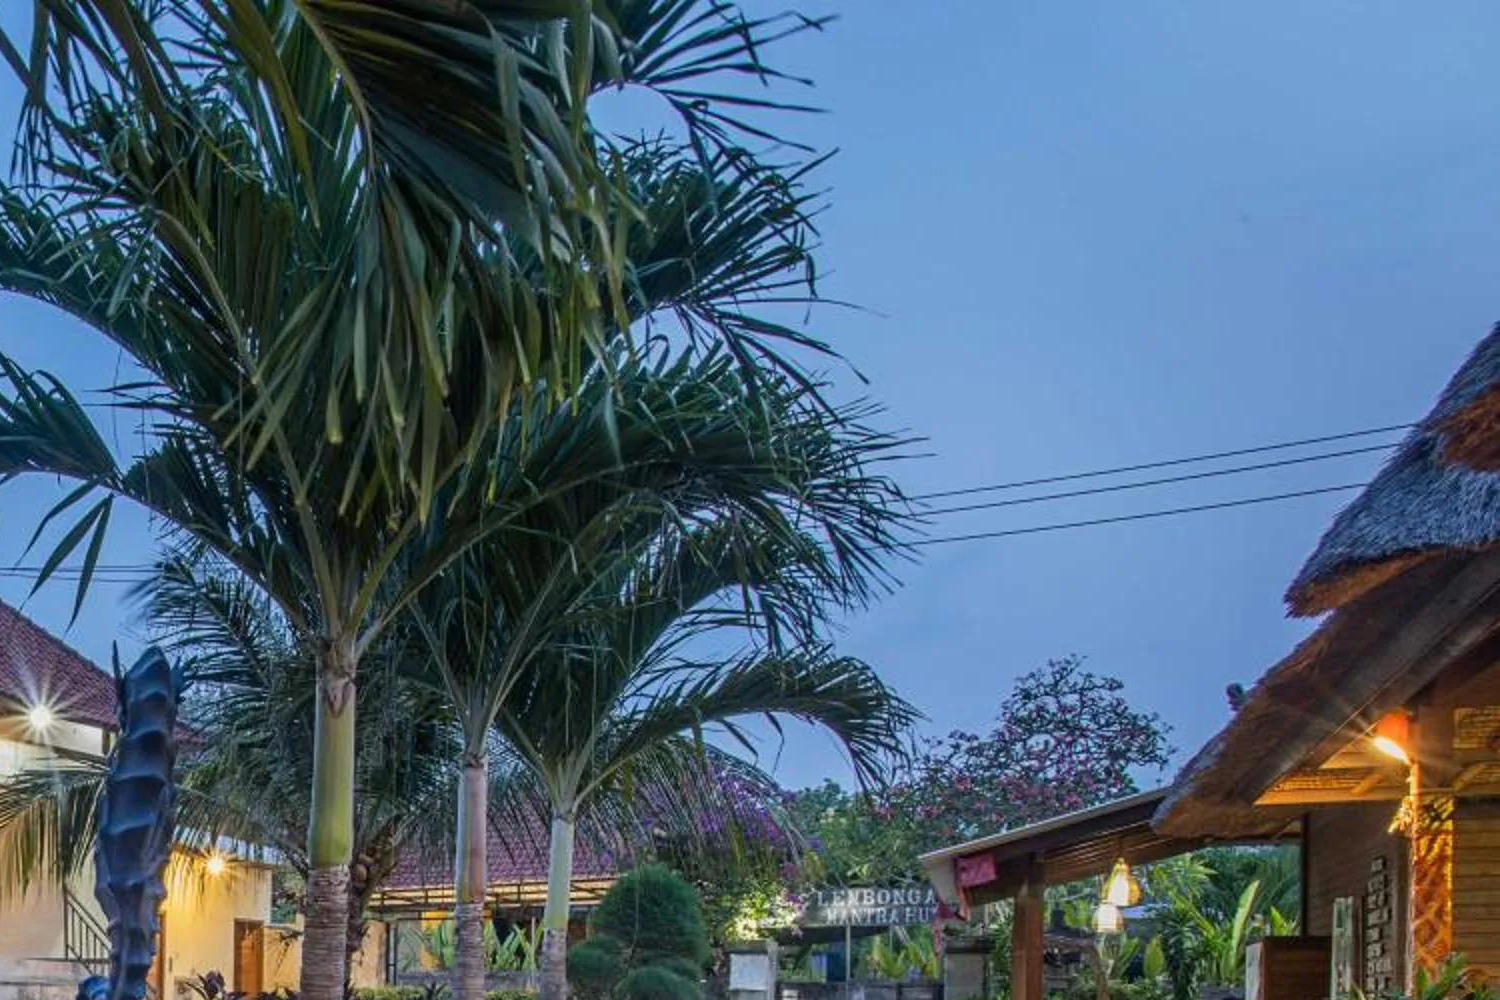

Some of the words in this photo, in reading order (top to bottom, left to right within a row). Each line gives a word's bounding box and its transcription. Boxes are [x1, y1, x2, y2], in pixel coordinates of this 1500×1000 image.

[817, 888, 937, 907] LEMBONGA
[826, 906, 900, 925] MANTRA
[905, 906, 938, 924] HU
